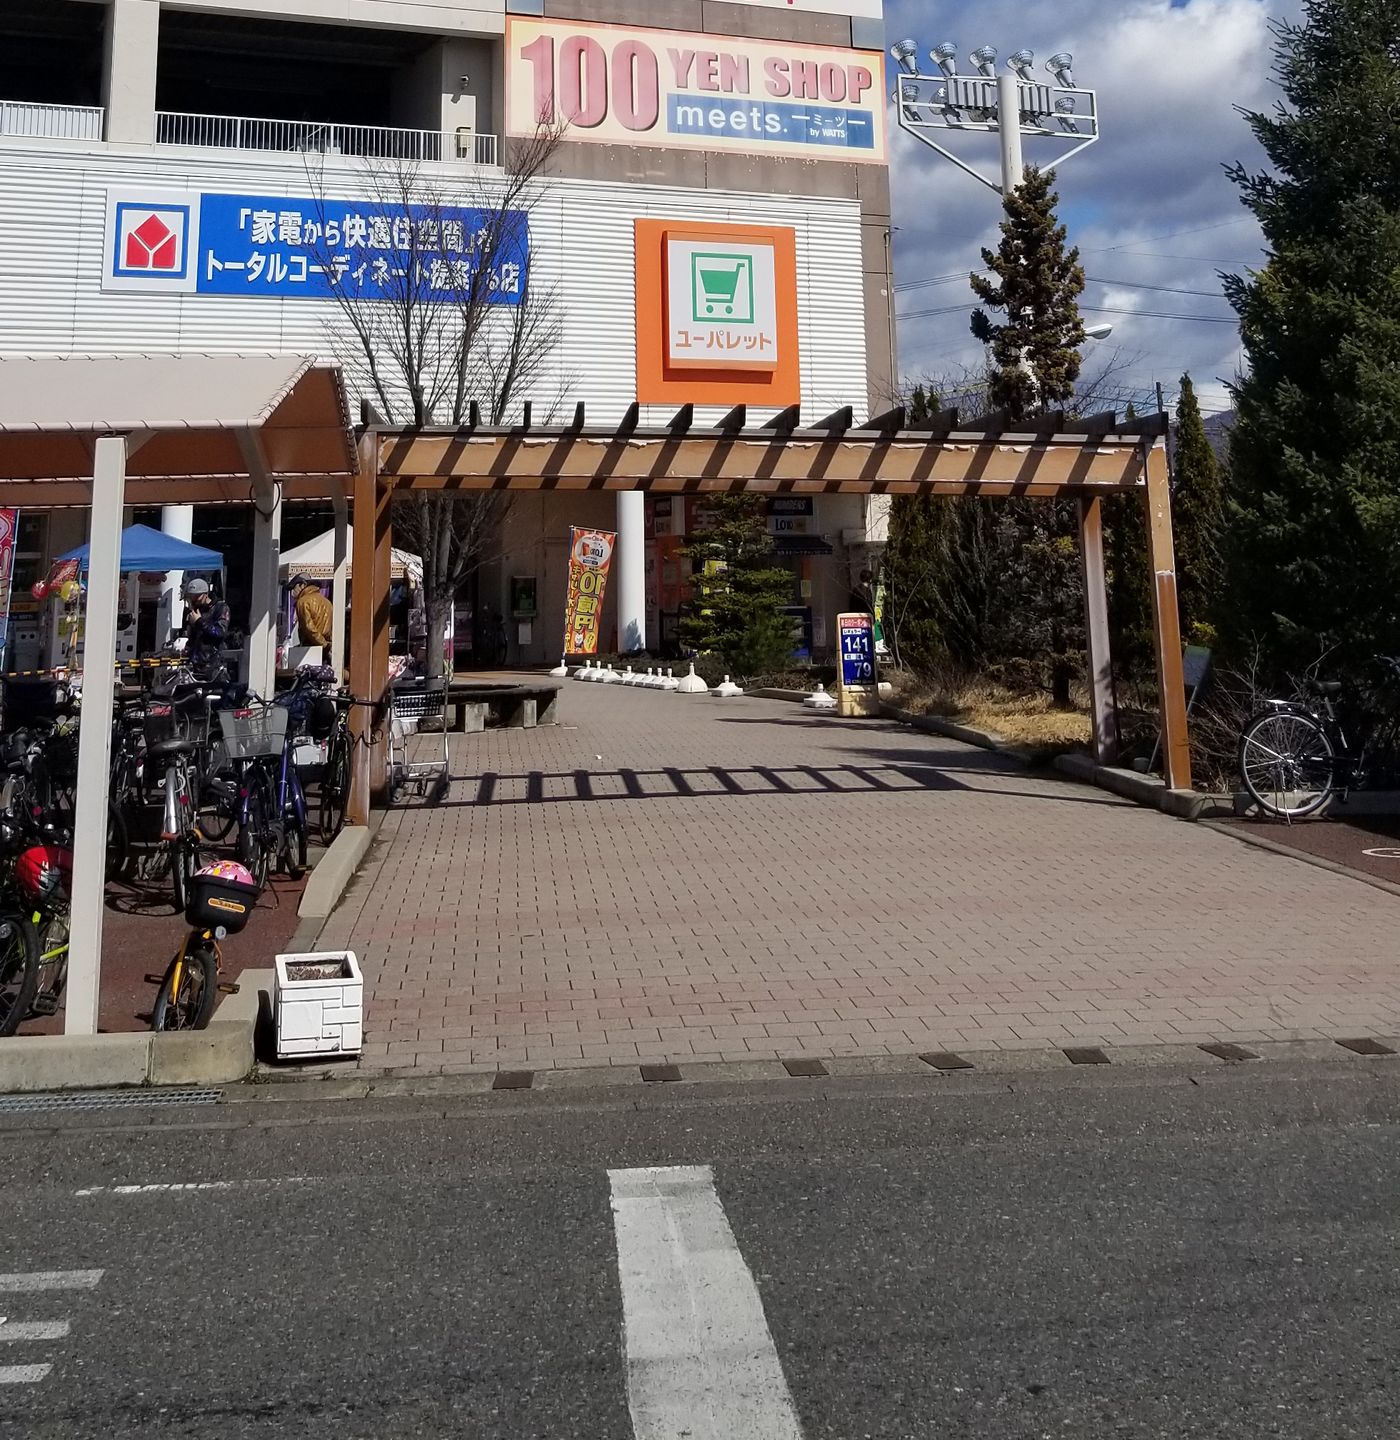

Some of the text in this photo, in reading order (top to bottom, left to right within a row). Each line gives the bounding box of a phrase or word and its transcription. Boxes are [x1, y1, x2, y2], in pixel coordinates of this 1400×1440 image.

[520, 34, 873, 132] 100 YEN SHOP
[809, 127, 847, 139] by WATTS
[207, 249, 520, 293] トータルコーディネート提案る店
[675, 329, 772, 350] ユーパレット
[844, 636, 869, 652] 141
[853, 661, 872, 678] 79
